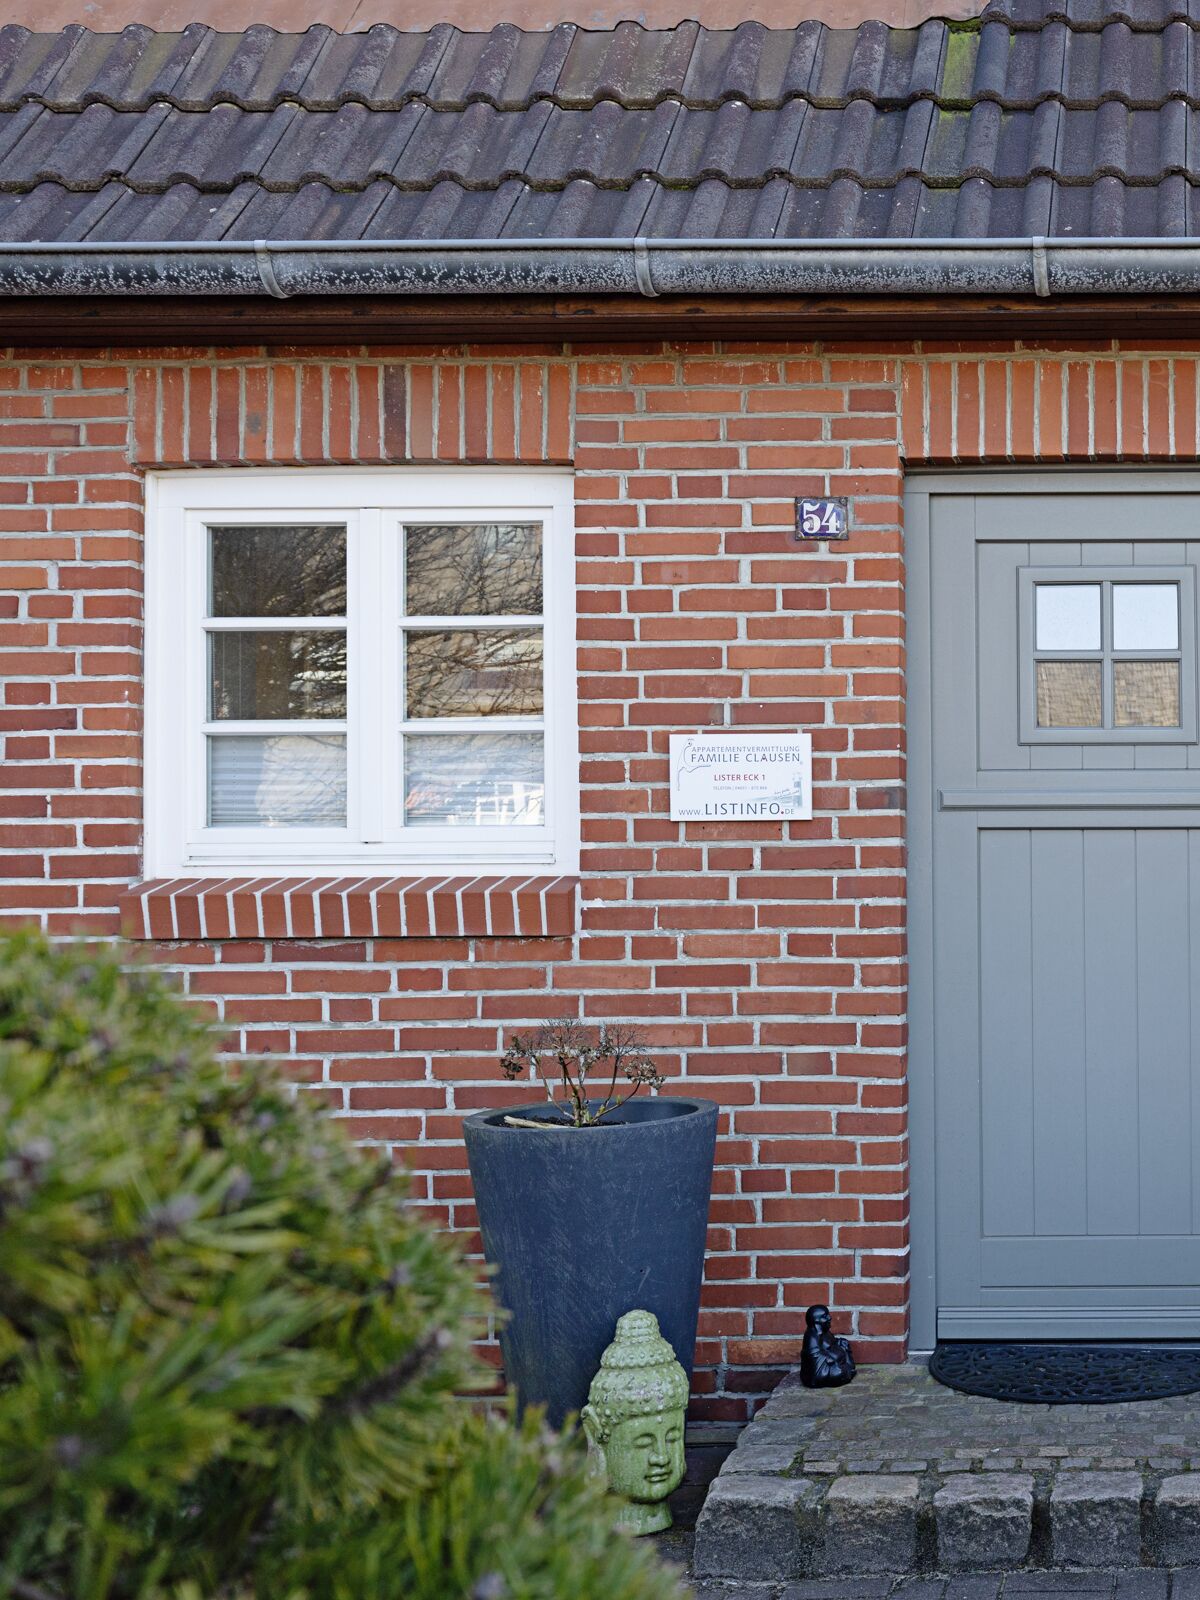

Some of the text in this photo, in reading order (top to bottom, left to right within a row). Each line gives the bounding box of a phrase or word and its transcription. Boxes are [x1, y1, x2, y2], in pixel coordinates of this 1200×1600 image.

[802, 502, 840, 534] 54
[691, 752, 801, 763] FAMILIE CLAUSEN
